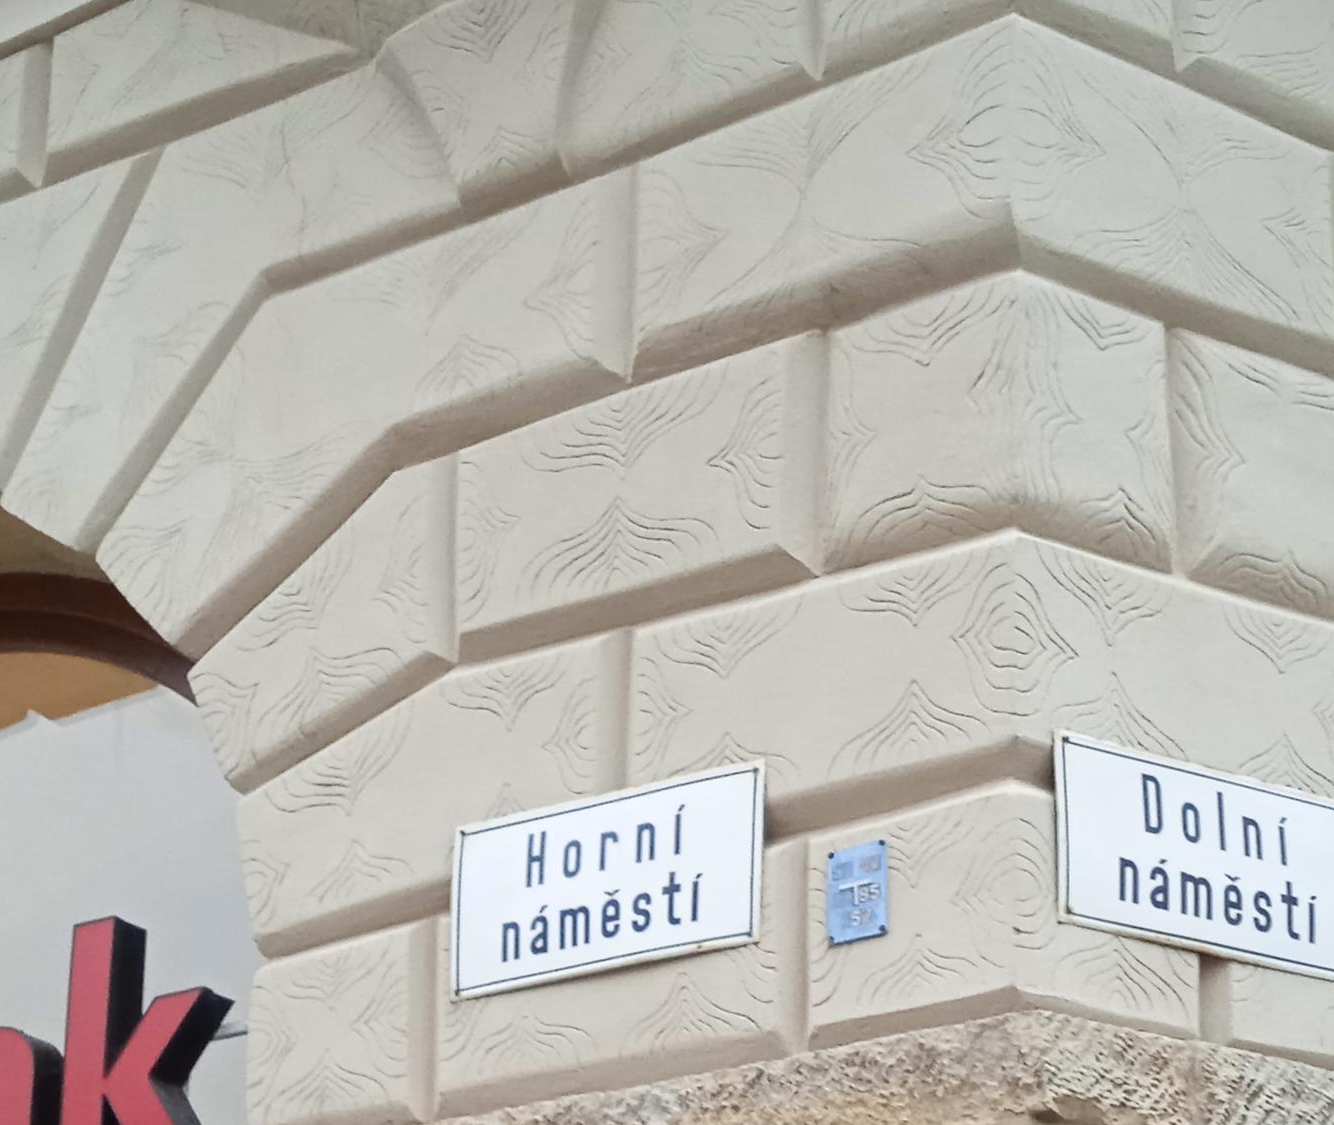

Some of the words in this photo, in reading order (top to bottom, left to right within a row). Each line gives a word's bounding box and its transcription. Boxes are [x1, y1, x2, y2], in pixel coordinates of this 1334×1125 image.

[525, 803, 686, 888] Horní
[1141, 773, 1289, 867] Dolní
[501, 872, 703, 963] náměstí
[1118, 856, 1318, 945] náměstí
